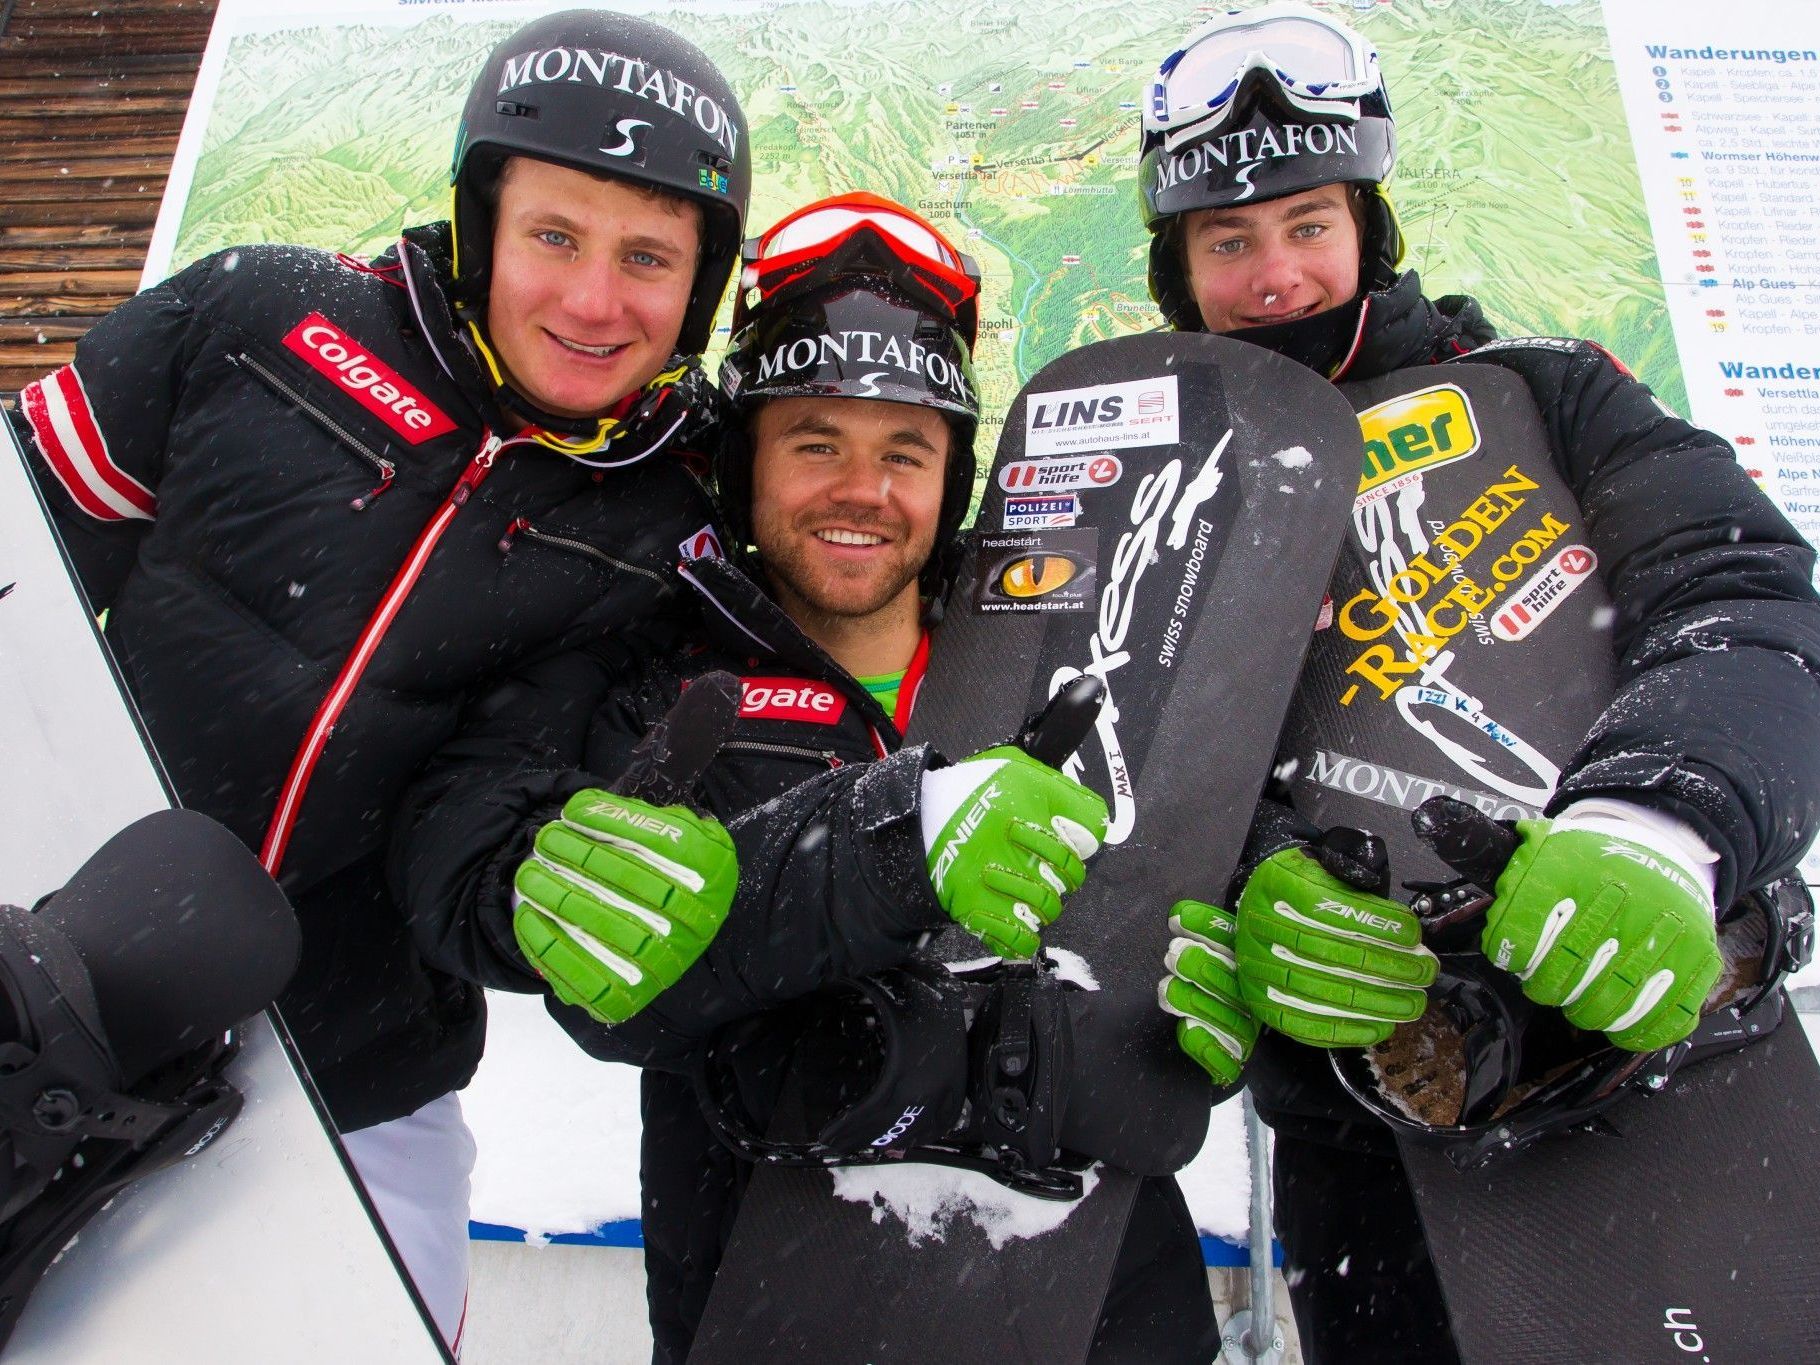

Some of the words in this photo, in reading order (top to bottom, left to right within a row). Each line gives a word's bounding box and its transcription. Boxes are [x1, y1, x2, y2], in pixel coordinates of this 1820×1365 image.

[1645, 45, 1818, 64] Wanderungen
[499, 47, 738, 160] MONTAFON
[945, 121, 997, 130] Partenen
[995, 157, 1045, 169] Versettla
[1156, 123, 1360, 196] MONTAFON
[1701, 151, 1762, 162] Wormser
[931, 171, 979, 180] Versettla
[918, 200, 973, 210] Gaschurn
[929, 211, 951, 219] 1000
[1732, 278, 1756, 290] Alp
[1759, 278, 1797, 290] Gues
[755, 331, 968, 403] MONTAFON
[301, 325, 432, 430] Colgate
[1757, 387, 1819, 399] Versettla
[1031, 396, 1125, 429] LINS
[1128, 415, 1175, 427] SEAT
[1054, 431, 1151, 448] www.autohaus-lins.at
[1037, 461, 1087, 476] sport
[1777, 469, 1808, 481] Alpe
[1037, 473, 1080, 486] hilfe
[1355, 485, 1390, 508] SINCE
[1391, 472, 1422, 491] 1856
[1008, 501, 1064, 514] POLIZEI
[1007, 515, 1048, 526] SPORT
[1338, 464, 1541, 642] GOLDEN
[1158, 617, 1183, 668] swiss
[1173, 517, 1214, 618] snowboard
[1521, 567, 1561, 607] sport
[1530, 578, 1567, 614] hilfe
[981, 600, 1085, 612] www.headstart.at
[1113, 765, 1133, 799] MAX
[1304, 750, 1546, 821] MONTFO
[582, 800, 684, 845] ZANIER
[929, 780, 1003, 897] ZANIER
[1312, 896, 1404, 935] ZANIER
